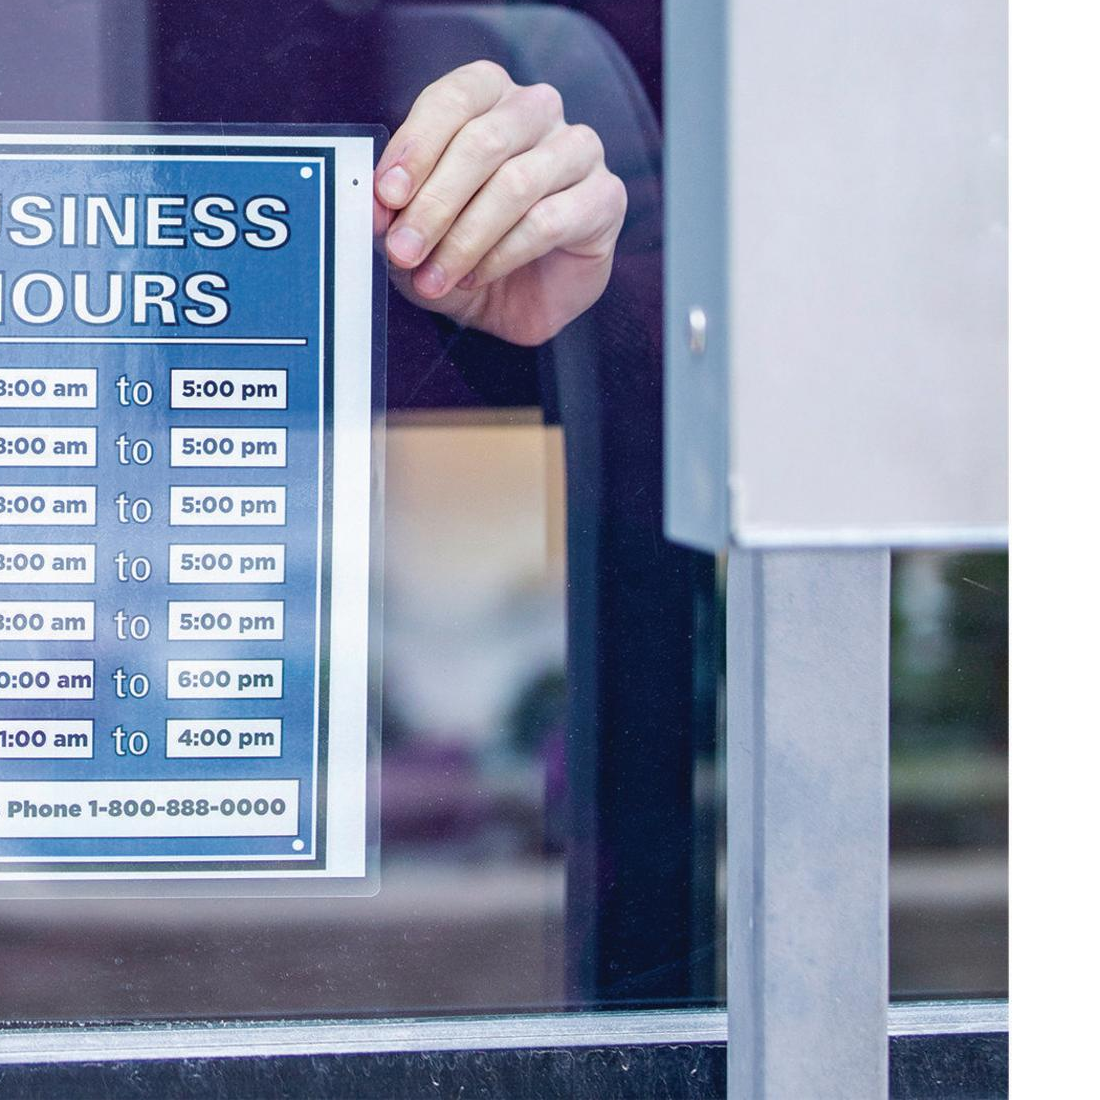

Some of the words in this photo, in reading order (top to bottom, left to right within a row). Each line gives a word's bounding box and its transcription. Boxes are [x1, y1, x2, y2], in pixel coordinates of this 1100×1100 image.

[52, 383, 88, 397] am
[115, 375, 154, 406] to
[181, 379, 235, 398] 5:00
[241, 383, 278, 401] pm
[52, 440, 88, 455] am
[115, 434, 153, 465] to
[181, 437, 235, 456] 5:00
[241, 441, 277, 459] pm
[52, 499, 87, 514] am
[114, 493, 153, 524] to
[180, 495, 234, 514] 5:00
[240, 499, 277, 517] pm
[51, 556, 87, 571] am
[113, 551, 152, 582] to
[180, 553, 233, 571] 5:00
[239, 556, 276, 574] pm
[50, 616, 86, 631] am
[113, 610, 151, 641] to
[179, 612, 232, 631] 5:00
[239, 616, 275, 634] pm
[56, 674, 92, 689] am
[112, 668, 150, 699] to
[178, 670, 231, 688] 6:00
[238, 673, 274, 691] pm
[53, 733, 88, 748] am
[111, 726, 149, 756] to
[177, 728, 232, 747] 4:00
[238, 731, 275, 750] pm
[7, 799, 82, 818] Phone
[88, 798, 286, 818] 1-800-888-0000
